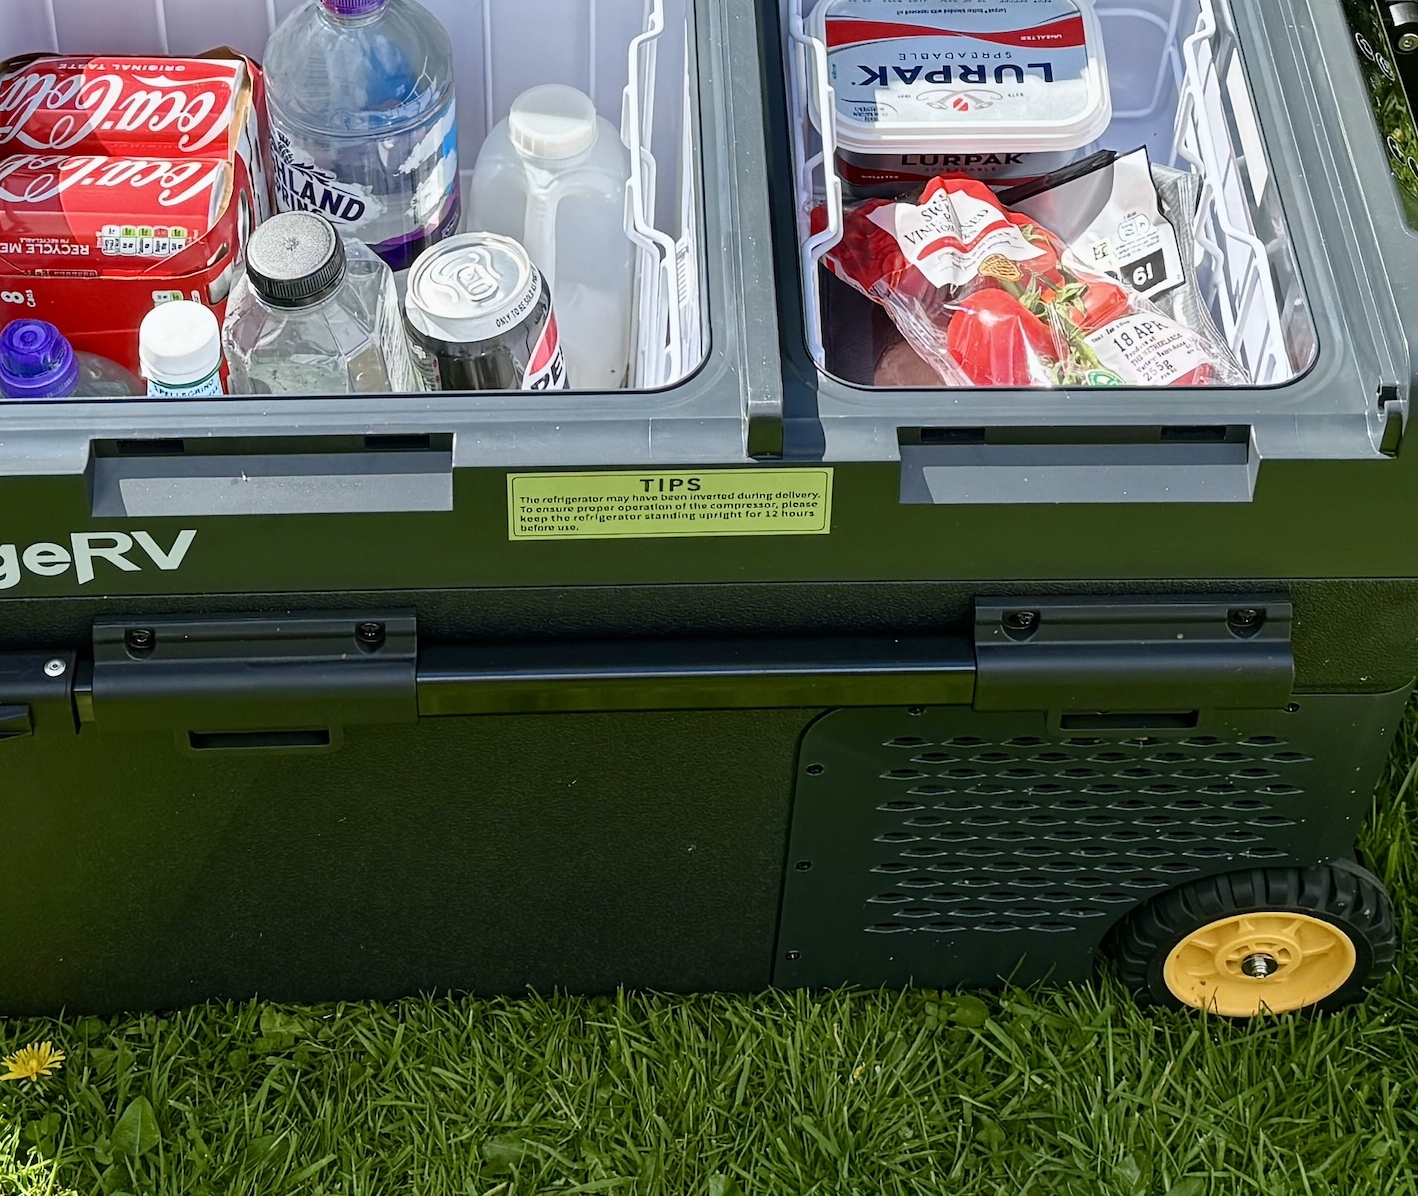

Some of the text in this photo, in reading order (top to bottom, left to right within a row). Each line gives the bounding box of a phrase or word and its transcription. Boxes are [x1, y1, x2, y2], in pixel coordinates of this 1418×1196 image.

[1020, 33, 1062, 41] UNSALTED
[898, 51, 1012, 61] SPREADABLE
[858, 62, 1053, 86] LURPAK
[901, 154, 1023, 165] LURPAK
[272, 152, 365, 221] HLAND
[0, 243, 89, 255] RECYCLE ME
[1, 290, 25, 304] 8
[1113, 332, 1134, 352] 18
[1134, 320, 1169, 340] APR
[1143, 360, 1173, 382] 255g
[639, 478, 702, 492] TIPS
[542, 496, 603, 504] refrigerator
[775, 492, 820, 500] delivery.
[618, 504, 672, 512] operation
[781, 501, 818, 509] please
[520, 515, 548, 523] keep
[574, 514, 641, 522] refrigerator
[645, 511, 696, 520] standing
[699, 511, 742, 520] upright
